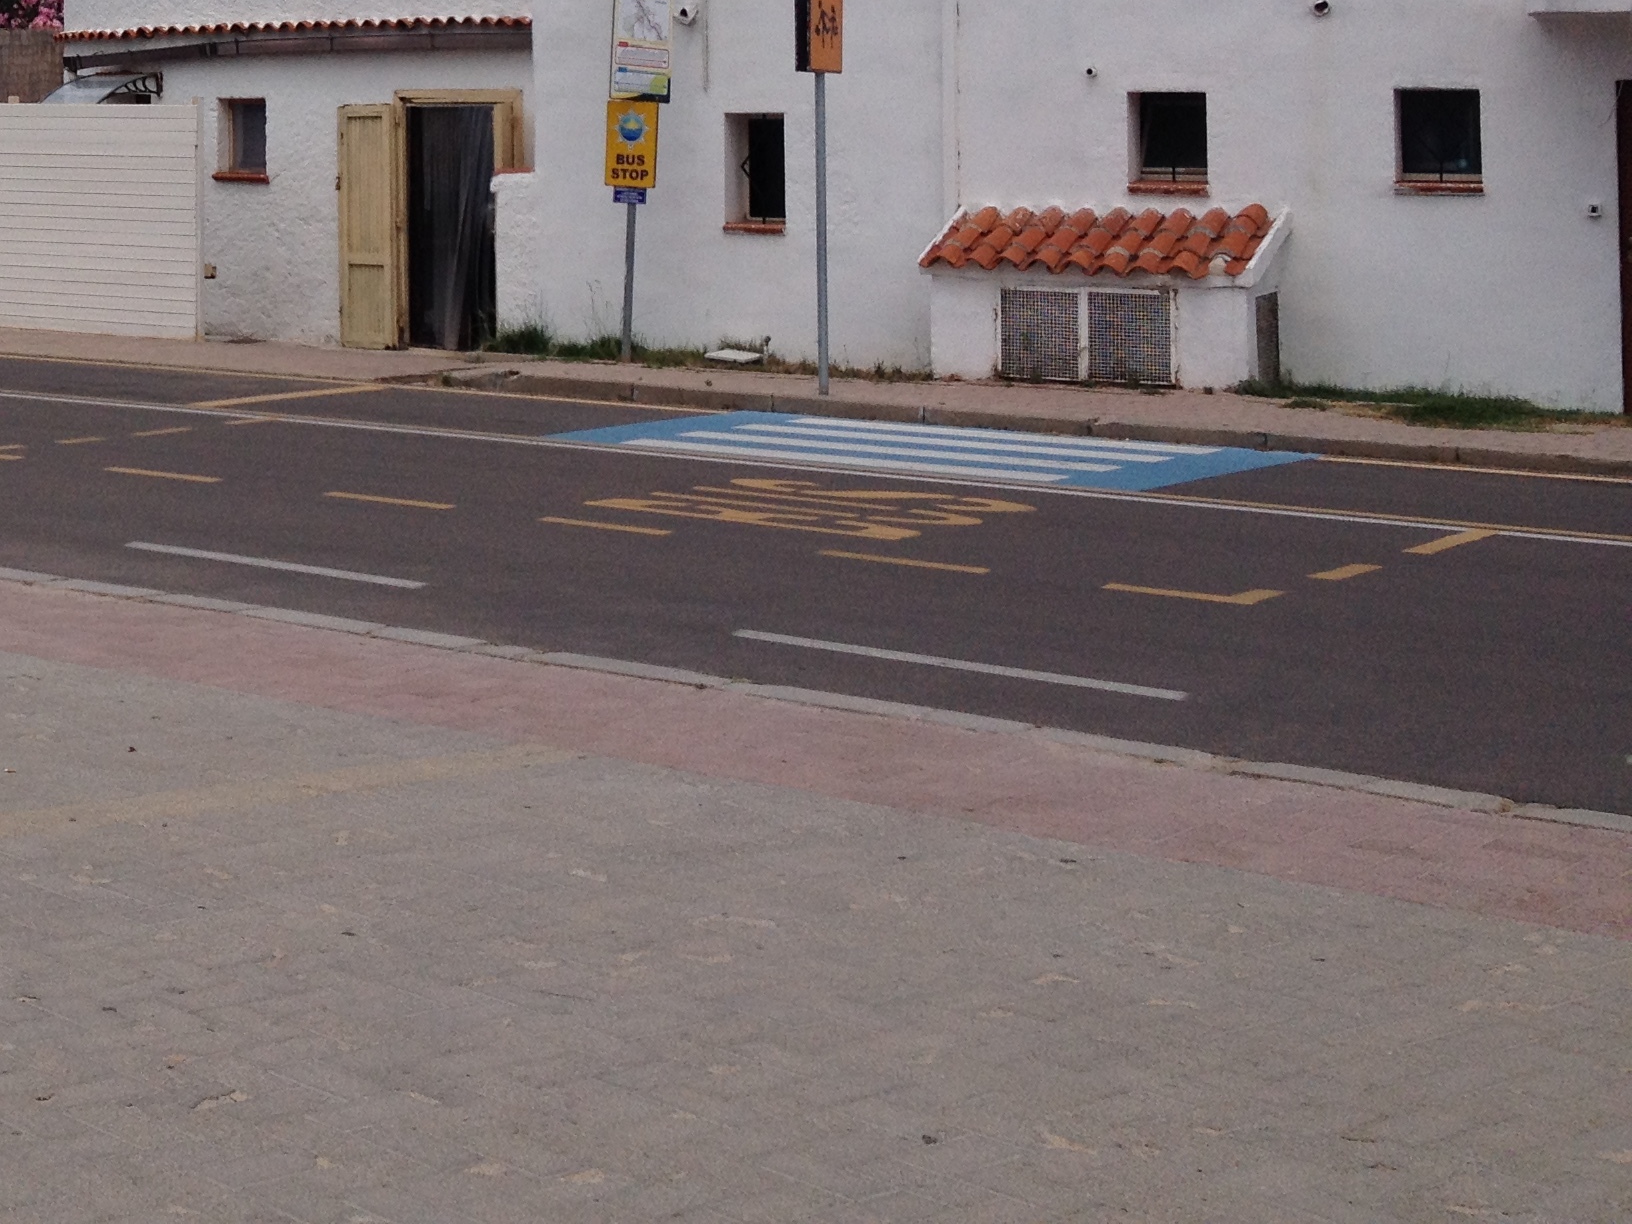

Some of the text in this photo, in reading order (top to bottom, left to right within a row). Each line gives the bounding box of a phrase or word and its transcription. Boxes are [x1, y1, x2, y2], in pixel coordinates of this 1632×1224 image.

[616, 154, 645, 166] BUS
[611, 168, 649, 180] STOP
[584, 477, 1038, 540] BUS
